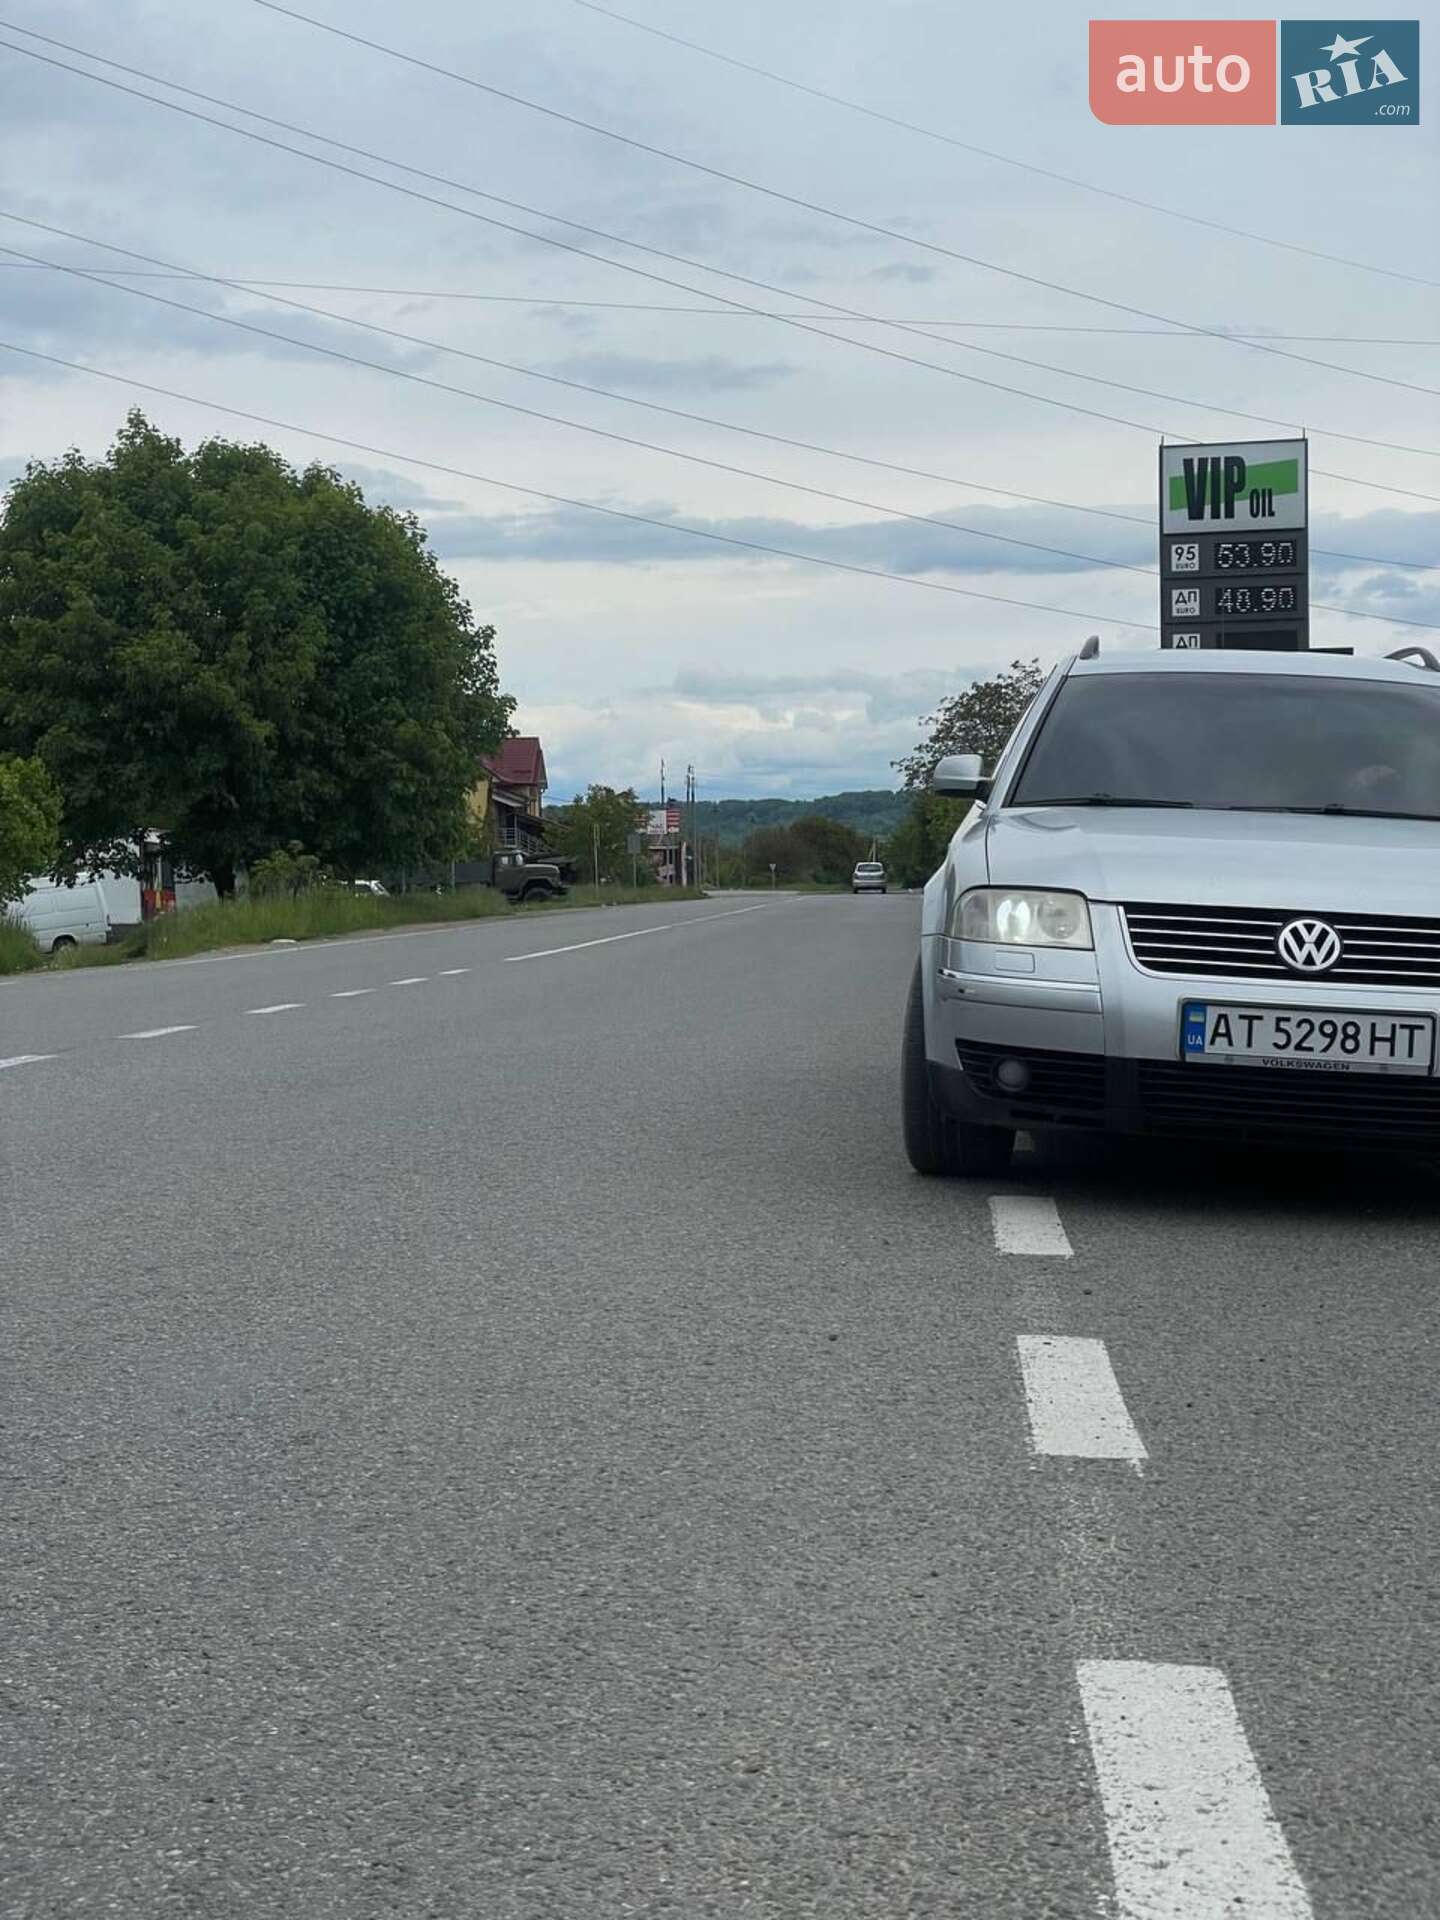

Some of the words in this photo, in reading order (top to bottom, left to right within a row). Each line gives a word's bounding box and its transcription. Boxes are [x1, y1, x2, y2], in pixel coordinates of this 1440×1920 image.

[1183, 456, 1246, 521] VIP
[1250, 488, 1275, 518] OIL
[1175, 546, 1196, 561] 95
[1218, 588, 1294, 613] 48.90
[1176, 607, 1196, 615] EURO
[1187, 1035, 1203, 1045] UA
[1209, 1013, 1263, 1048] AT
[1272, 1017, 1361, 1055] 5298
[1369, 1022, 1425, 1058] HT
[1262, 1058, 1350, 1071] VOLKSWAGEN
